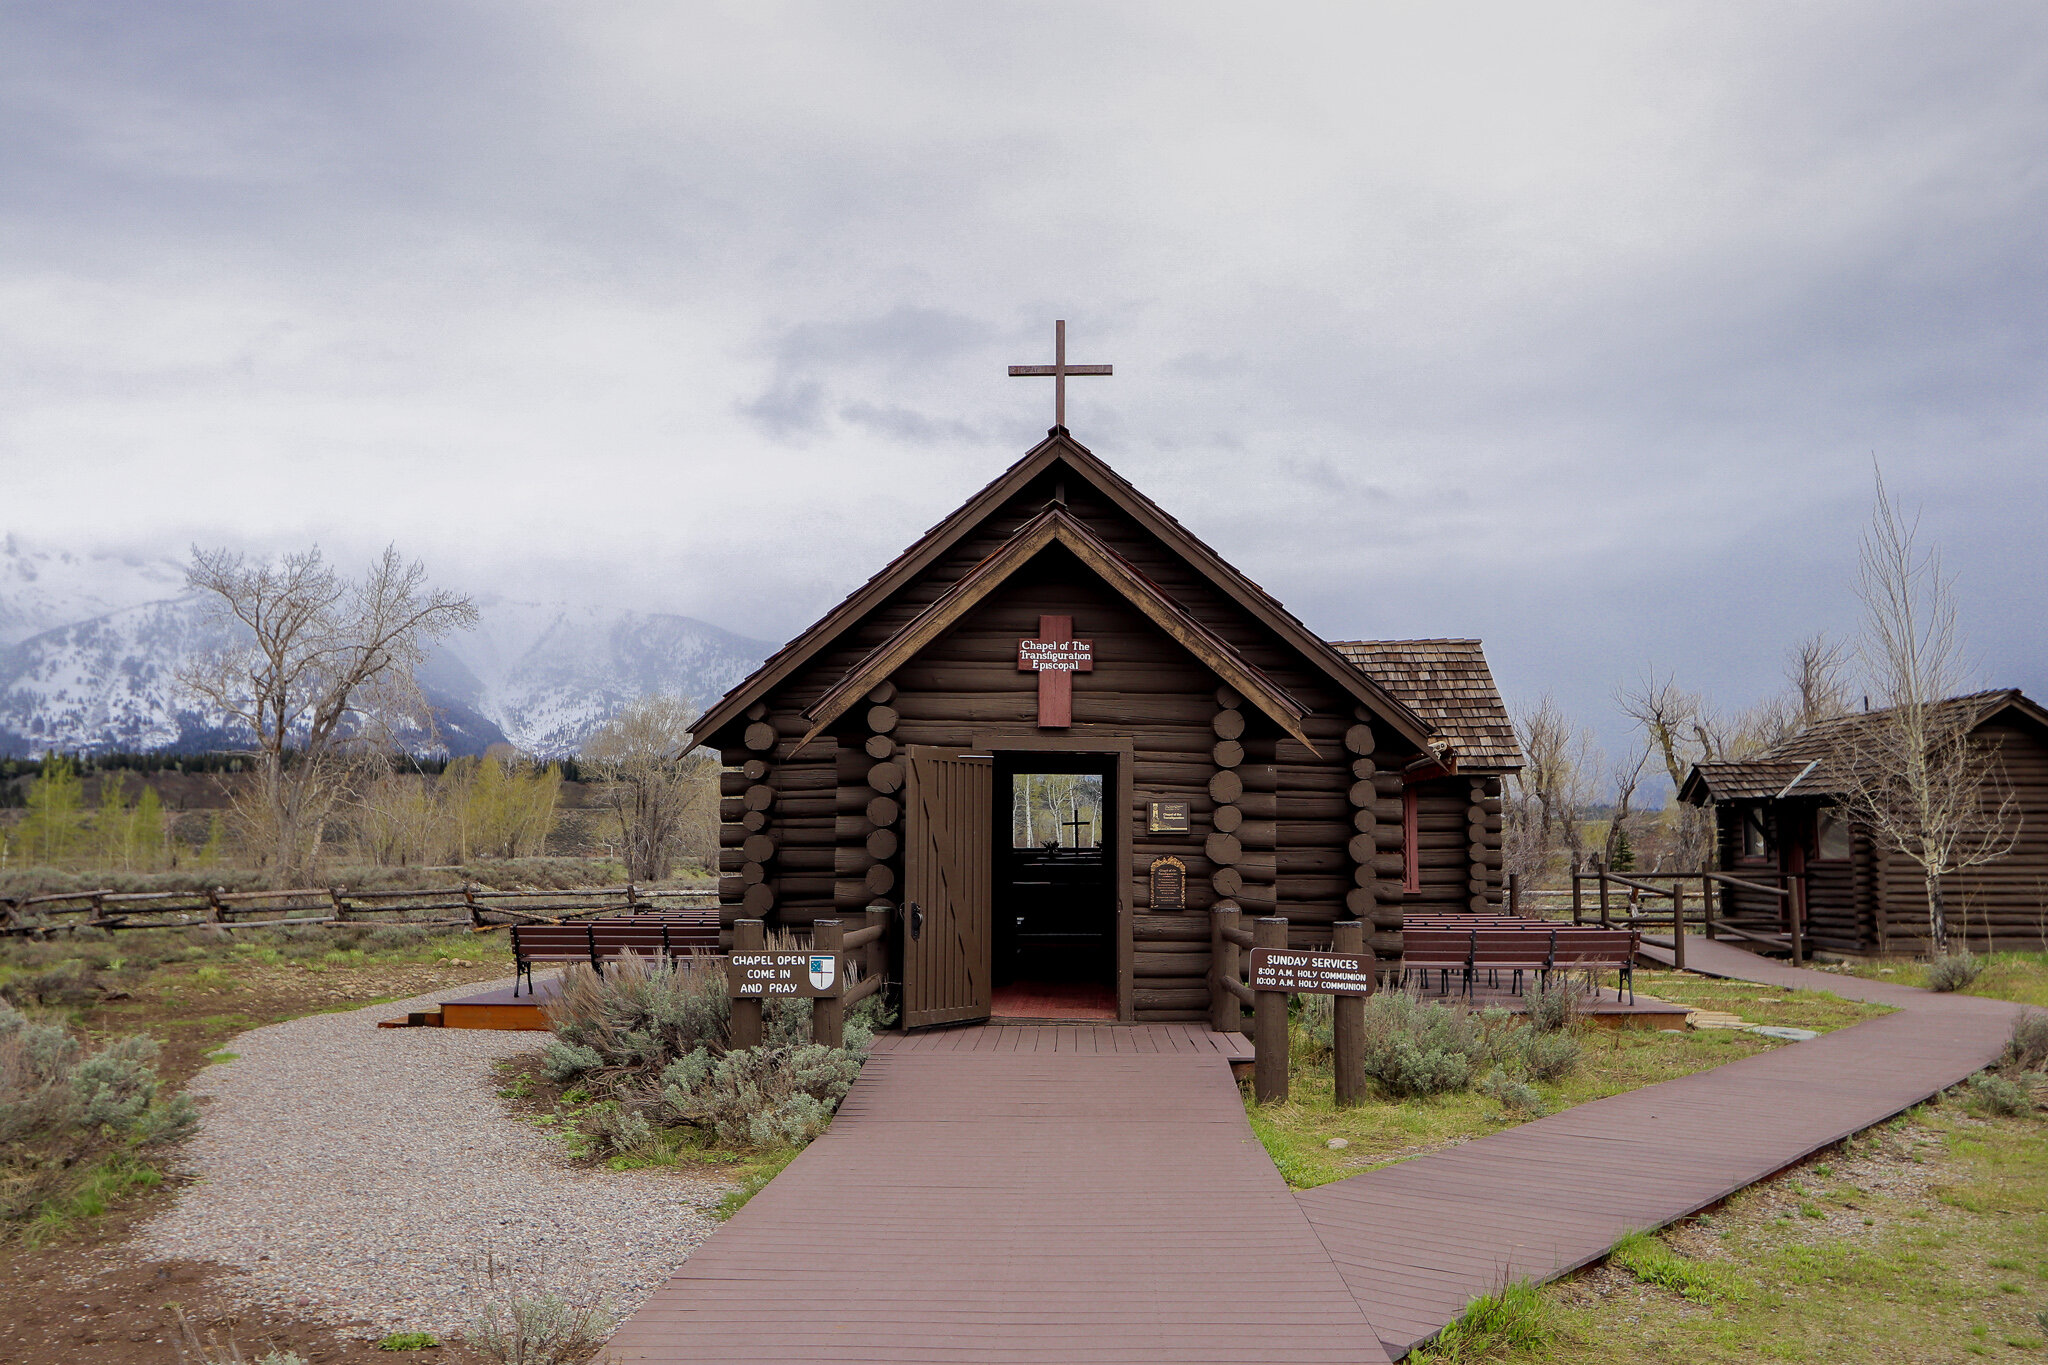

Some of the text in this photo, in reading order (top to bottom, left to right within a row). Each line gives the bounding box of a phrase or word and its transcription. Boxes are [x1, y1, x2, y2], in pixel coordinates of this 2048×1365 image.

[1021, 640, 1090, 653] Chapel of The
[1019, 650, 1091, 662] Transfiguration
[1032, 660, 1079, 672] Episcopal
[732, 955, 806, 966] CHAPEL OPEN
[1267, 954, 1359, 970] SUNDAY SERVICES
[747, 969, 791, 979] COME IN
[1258, 967, 1367, 982] 8:00 A.M. HOLY COMMUNION
[740, 983, 797, 993] AND PRAY
[1256, 977, 1367, 991] 10:00 A.M. HOLY COMMUNION
